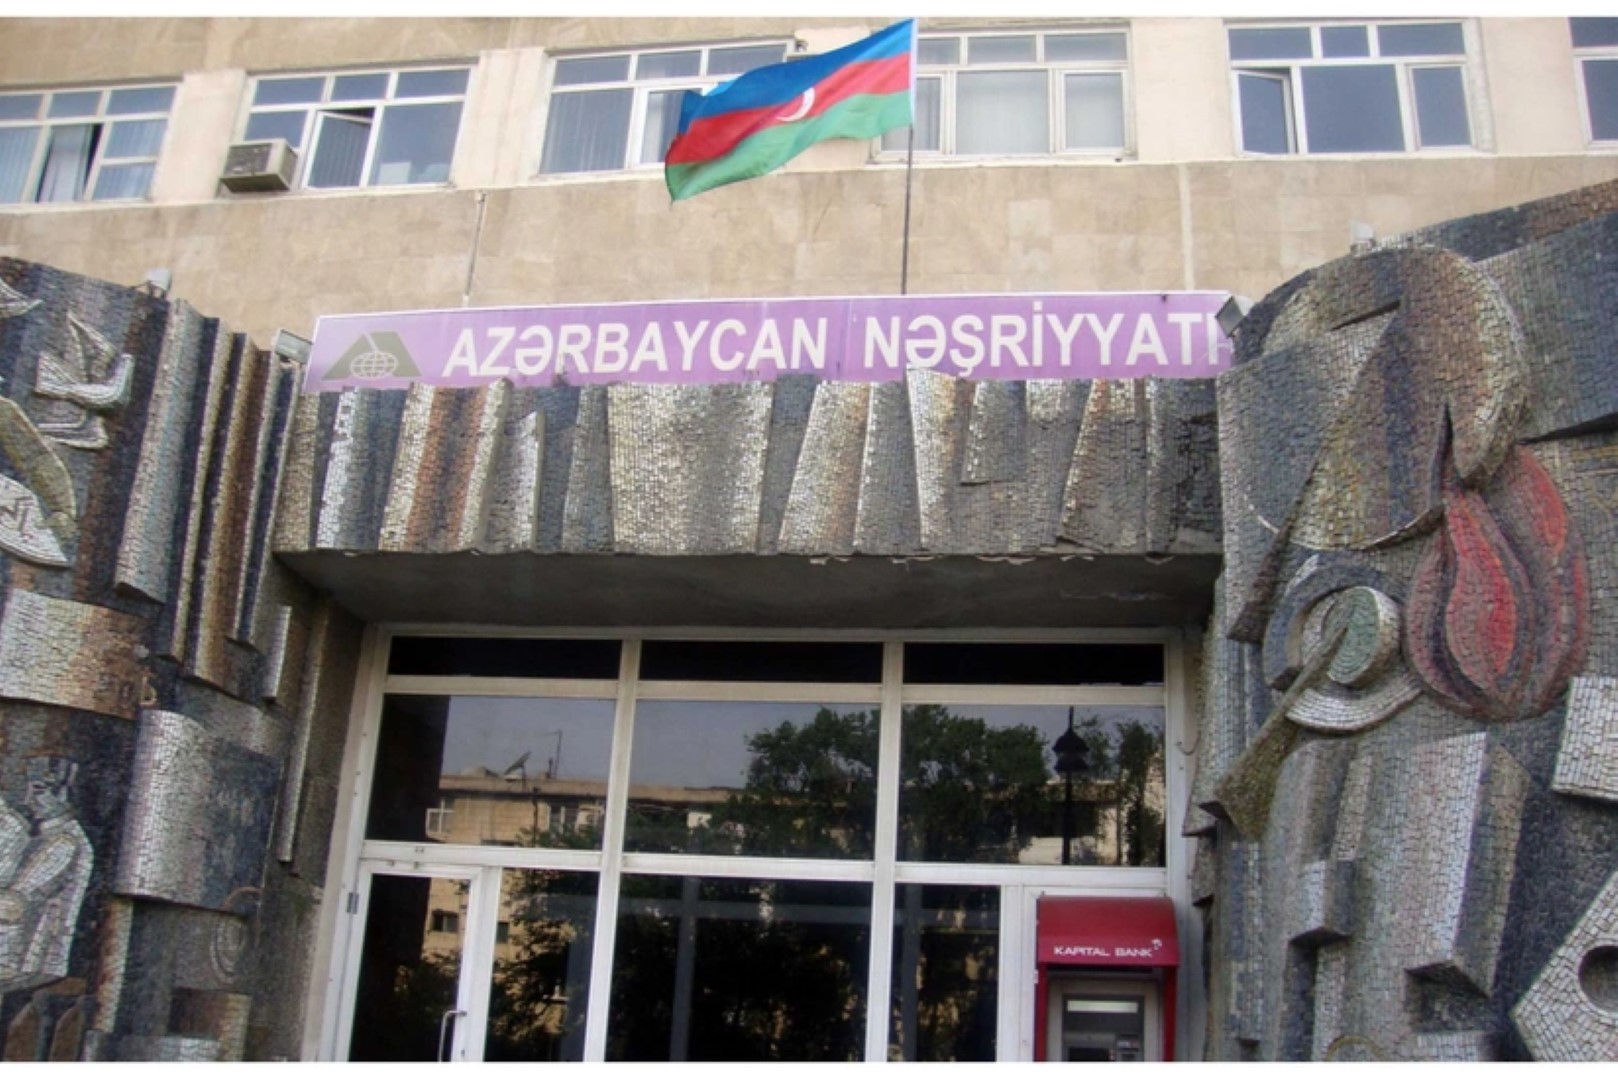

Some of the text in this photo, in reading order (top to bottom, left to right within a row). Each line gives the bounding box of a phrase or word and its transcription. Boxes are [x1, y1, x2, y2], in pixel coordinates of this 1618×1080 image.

[442, 301, 1219, 378] AZƏRBAYCAN NƏŞRİYYATI
[1054, 945, 1153, 958] KAPITAL BANK
